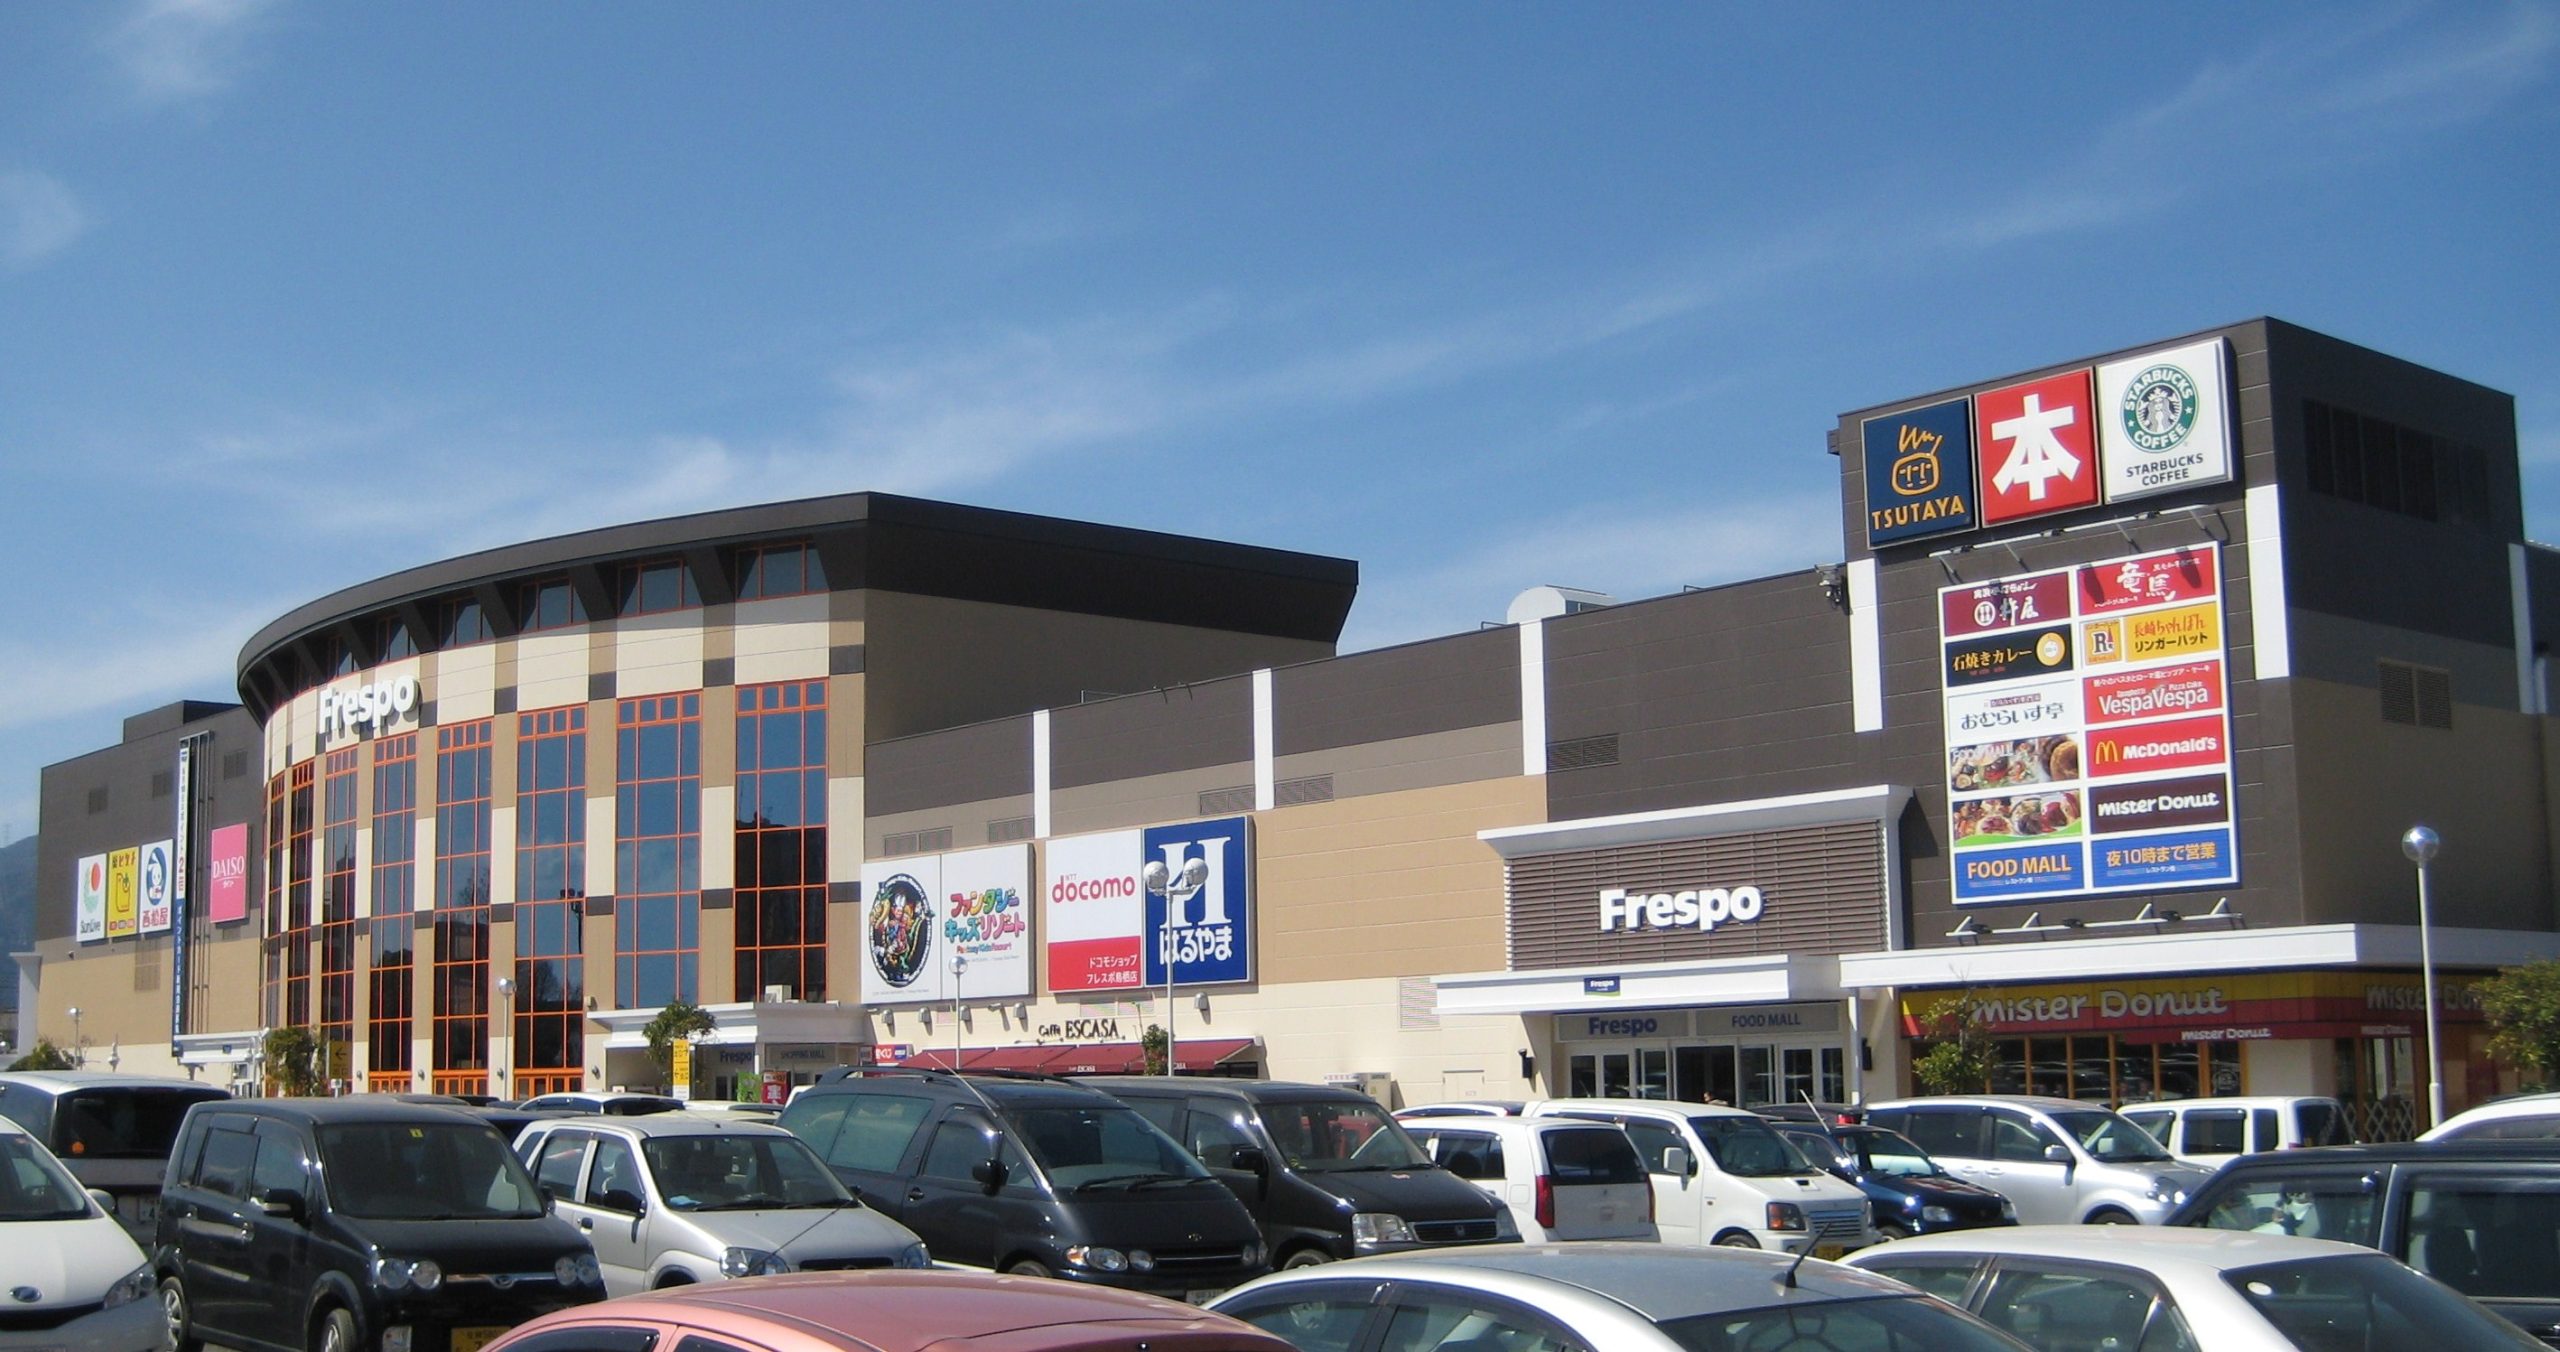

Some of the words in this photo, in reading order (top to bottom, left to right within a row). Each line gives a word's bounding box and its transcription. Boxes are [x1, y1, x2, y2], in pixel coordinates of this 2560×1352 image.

[2124, 368, 2194, 411] STARBUCKS
[1991, 393, 2081, 501] 本
[2133, 423, 2188, 449] COFFEE
[2126, 452, 2204, 478] STARBUCKS
[2141, 468, 2190, 486] COFFEE
[1871, 495, 1966, 530] TSUTAYA
[2134, 613, 2206, 638] 長崎ちゃんぽん
[2134, 632, 2208, 653] リンガーハット
[1952, 648, 2032, 671] 石焼きカレー
[319, 674, 416, 734] Frespo
[2098, 687, 2209, 716] VespaVespa
[1960, 702, 2064, 730] おむらいす亭
[2122, 735, 2218, 761] McDonald's
[2158, 791, 2220, 812] Donut
[212, 855, 245, 879] DAISO
[1967, 859, 2018, 880] FOOD
[2022, 853, 2072, 876] MALL
[2106, 841, 2217, 868] 夜10時まで営業
[1052, 875, 1135, 904] docomo
[1158, 836, 1232, 929] H
[950, 887, 1020, 918] ファンタジー
[1600, 885, 1762, 931] Frespo
[142, 907, 168, 928] 西松屋
[944, 911, 1026, 944] キッズリゾート
[1159, 925, 1232, 965] はるやま
[1089, 954, 1138, 969] ドコモショップ
[1086, 970, 1138, 985] フレスポ鳥栖店
[1972, 993, 2087, 1023] Mister
[2100, 987, 2228, 1019] Donut
[1065, 1018, 1119, 1040] ESCASA
[1588, 1016, 1657, 1038] Frespo
[1731, 1013, 1766, 1029] FOOD
[1767, 1011, 1801, 1027] MALL
[2225, 1027, 2272, 1039] Donut
